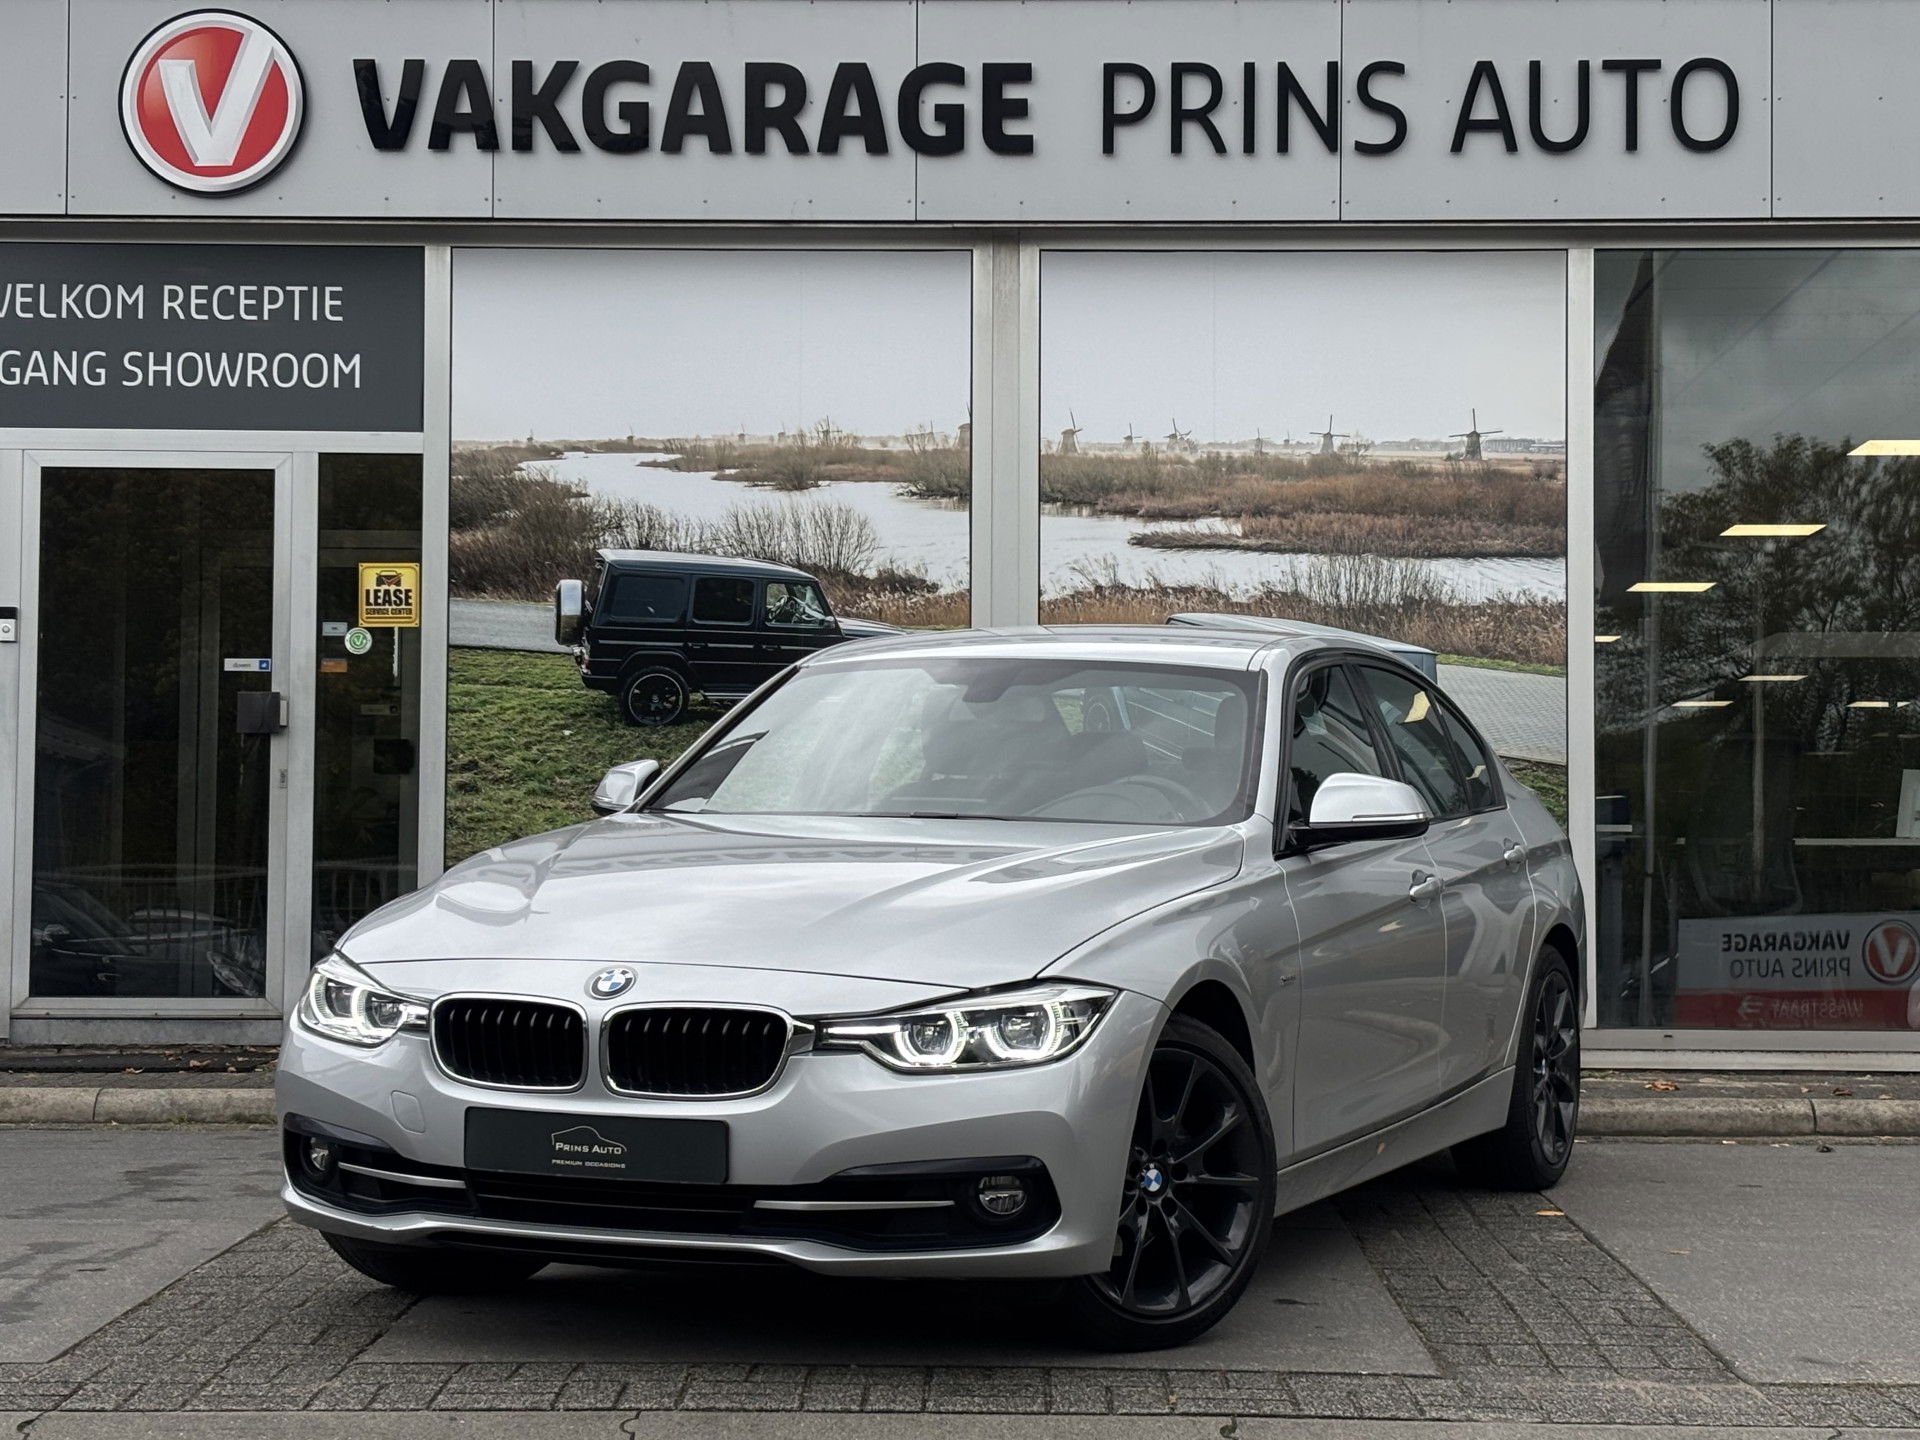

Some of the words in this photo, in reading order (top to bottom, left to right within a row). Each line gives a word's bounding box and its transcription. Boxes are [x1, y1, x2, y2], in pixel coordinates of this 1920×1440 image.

[352, 58, 1034, 155] VAKGARAGE
[1101, 60, 1408, 155] PRINS
[1449, 57, 1740, 153] AUTO
[162, 284, 344, 322] RECEPTIE
[0, 349, 107, 387] GANG
[121, 351, 361, 389] SHOWROOM
[365, 588, 413, 607] LEASE
[591, 1144, 622, 1155] AUTO
